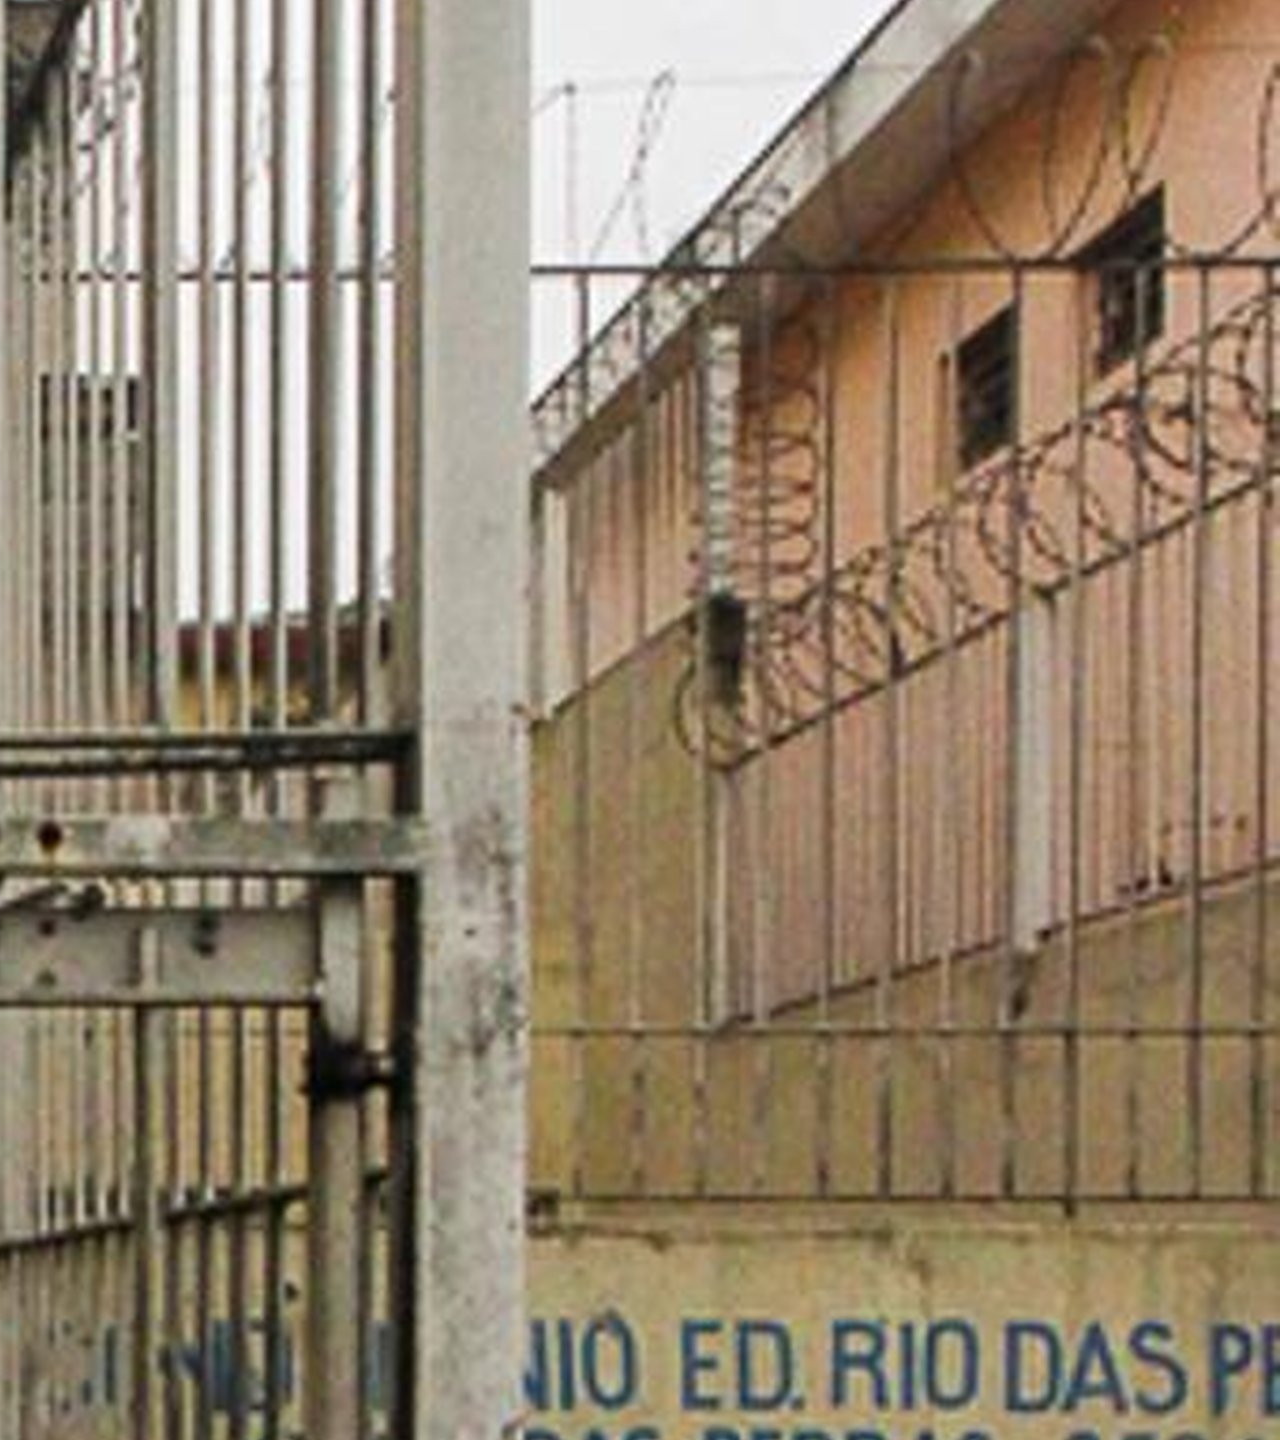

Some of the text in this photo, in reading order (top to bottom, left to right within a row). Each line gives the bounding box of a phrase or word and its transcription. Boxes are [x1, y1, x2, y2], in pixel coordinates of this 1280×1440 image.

[680, 1318, 804, 1410] ED.
[830, 1318, 978, 1410] RIO
[1004, 1319, 1188, 1416] DAS
